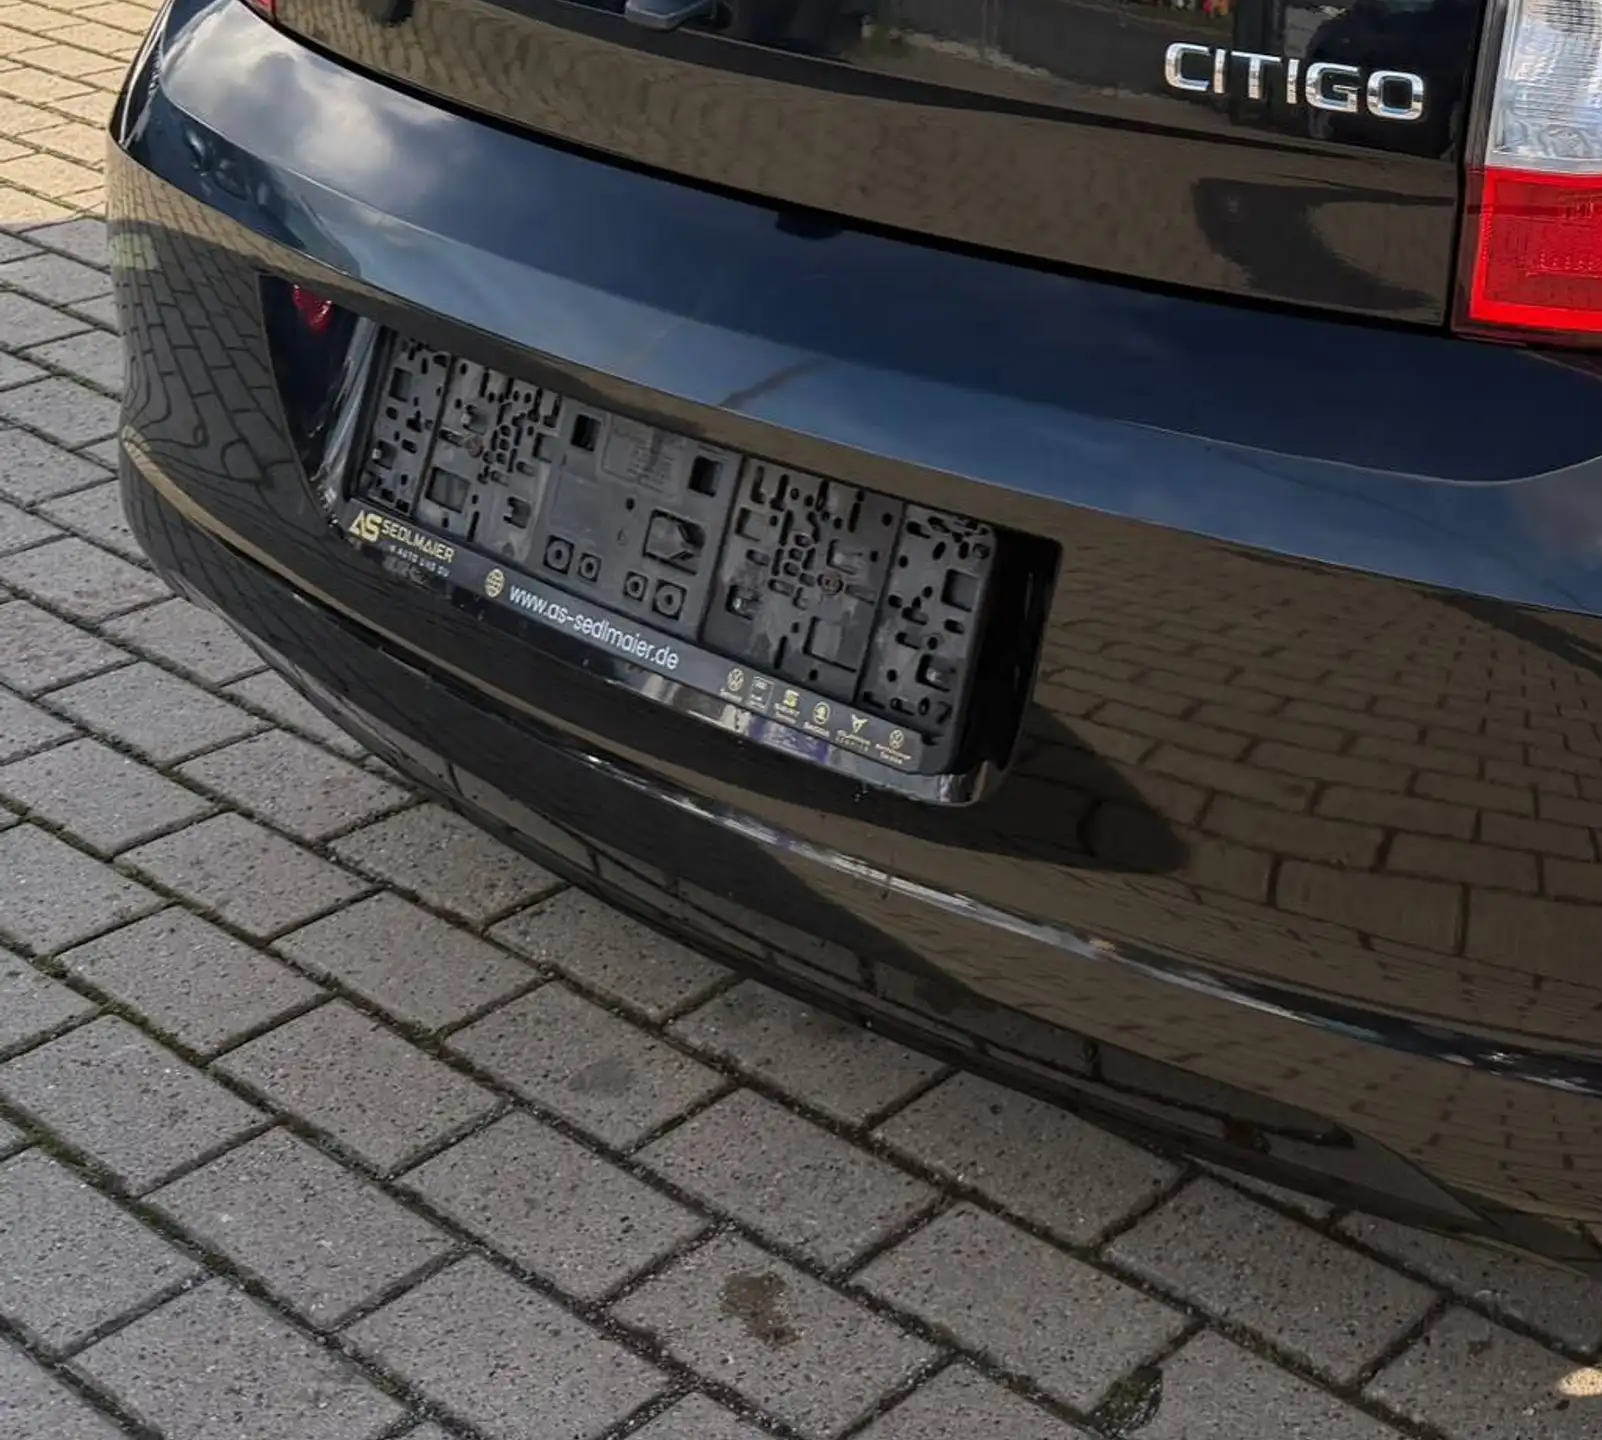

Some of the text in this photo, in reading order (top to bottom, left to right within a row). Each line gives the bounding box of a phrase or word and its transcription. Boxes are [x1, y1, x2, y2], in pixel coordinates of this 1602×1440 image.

[1164, 42, 1426, 121] CITIGO
[348, 510, 455, 564] AS SEDLMAIER
[509, 584, 680, 670] www.as-sedlmaier.de
